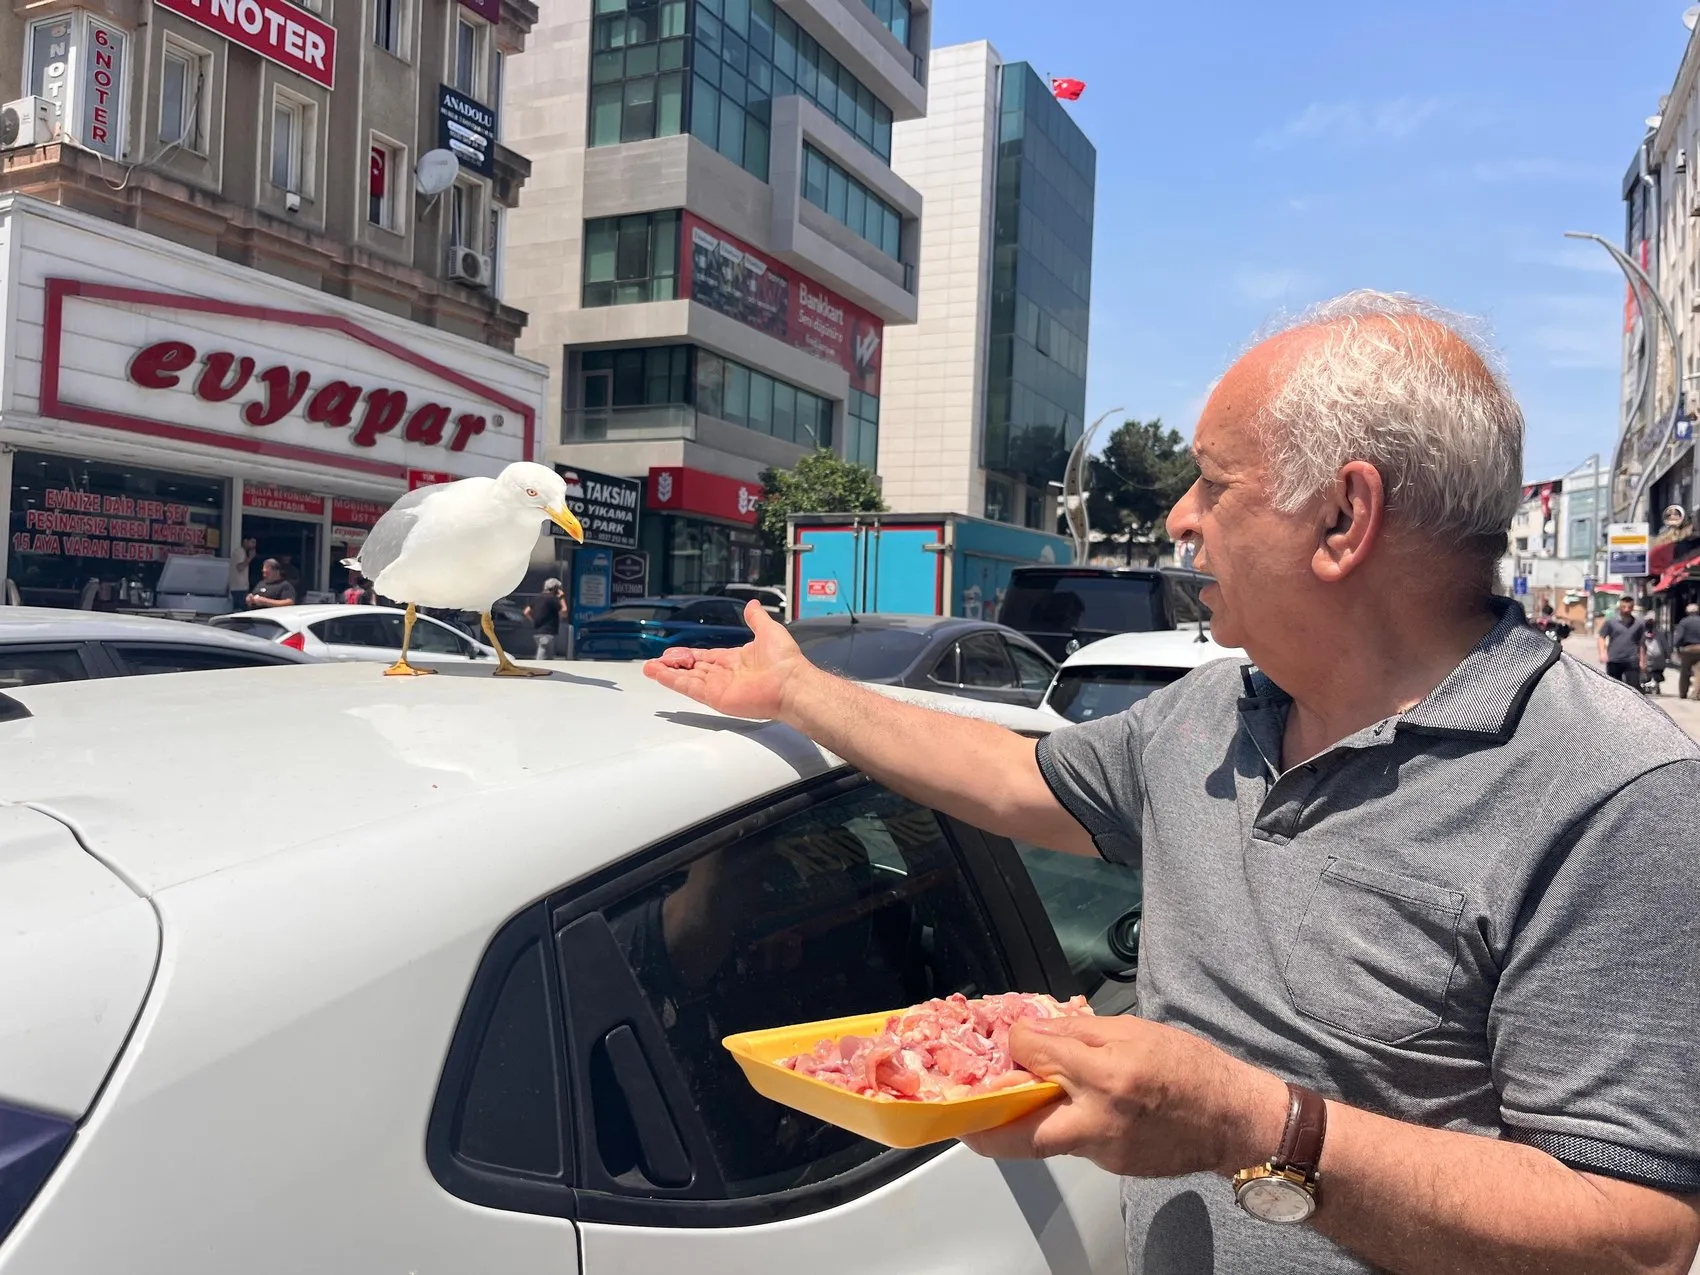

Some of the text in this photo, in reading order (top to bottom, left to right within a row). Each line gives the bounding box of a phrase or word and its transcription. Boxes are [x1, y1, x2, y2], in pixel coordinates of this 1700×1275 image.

[211, 0, 326, 71] NOTER
[92, 29, 115, 144] 6. NOTER
[443, 94, 493, 128] ANADOLU
[127, 340, 487, 453] evyapar
[45, 486, 191, 525] EVİNİZE DAİR HER ŞEY
[586, 480, 637, 509] TAKSİM
[27, 508, 207, 546] PEŞİNATSIZ KREDİ KARTSIZ
[588, 505, 634, 523] YIKAMA
[592, 519, 625, 534] PARK
[13, 532, 31, 551] 15
[33, 533, 61, 555] AYA
[64, 536, 110, 560] VARAN
[112, 540, 155, 562] ELDEN
